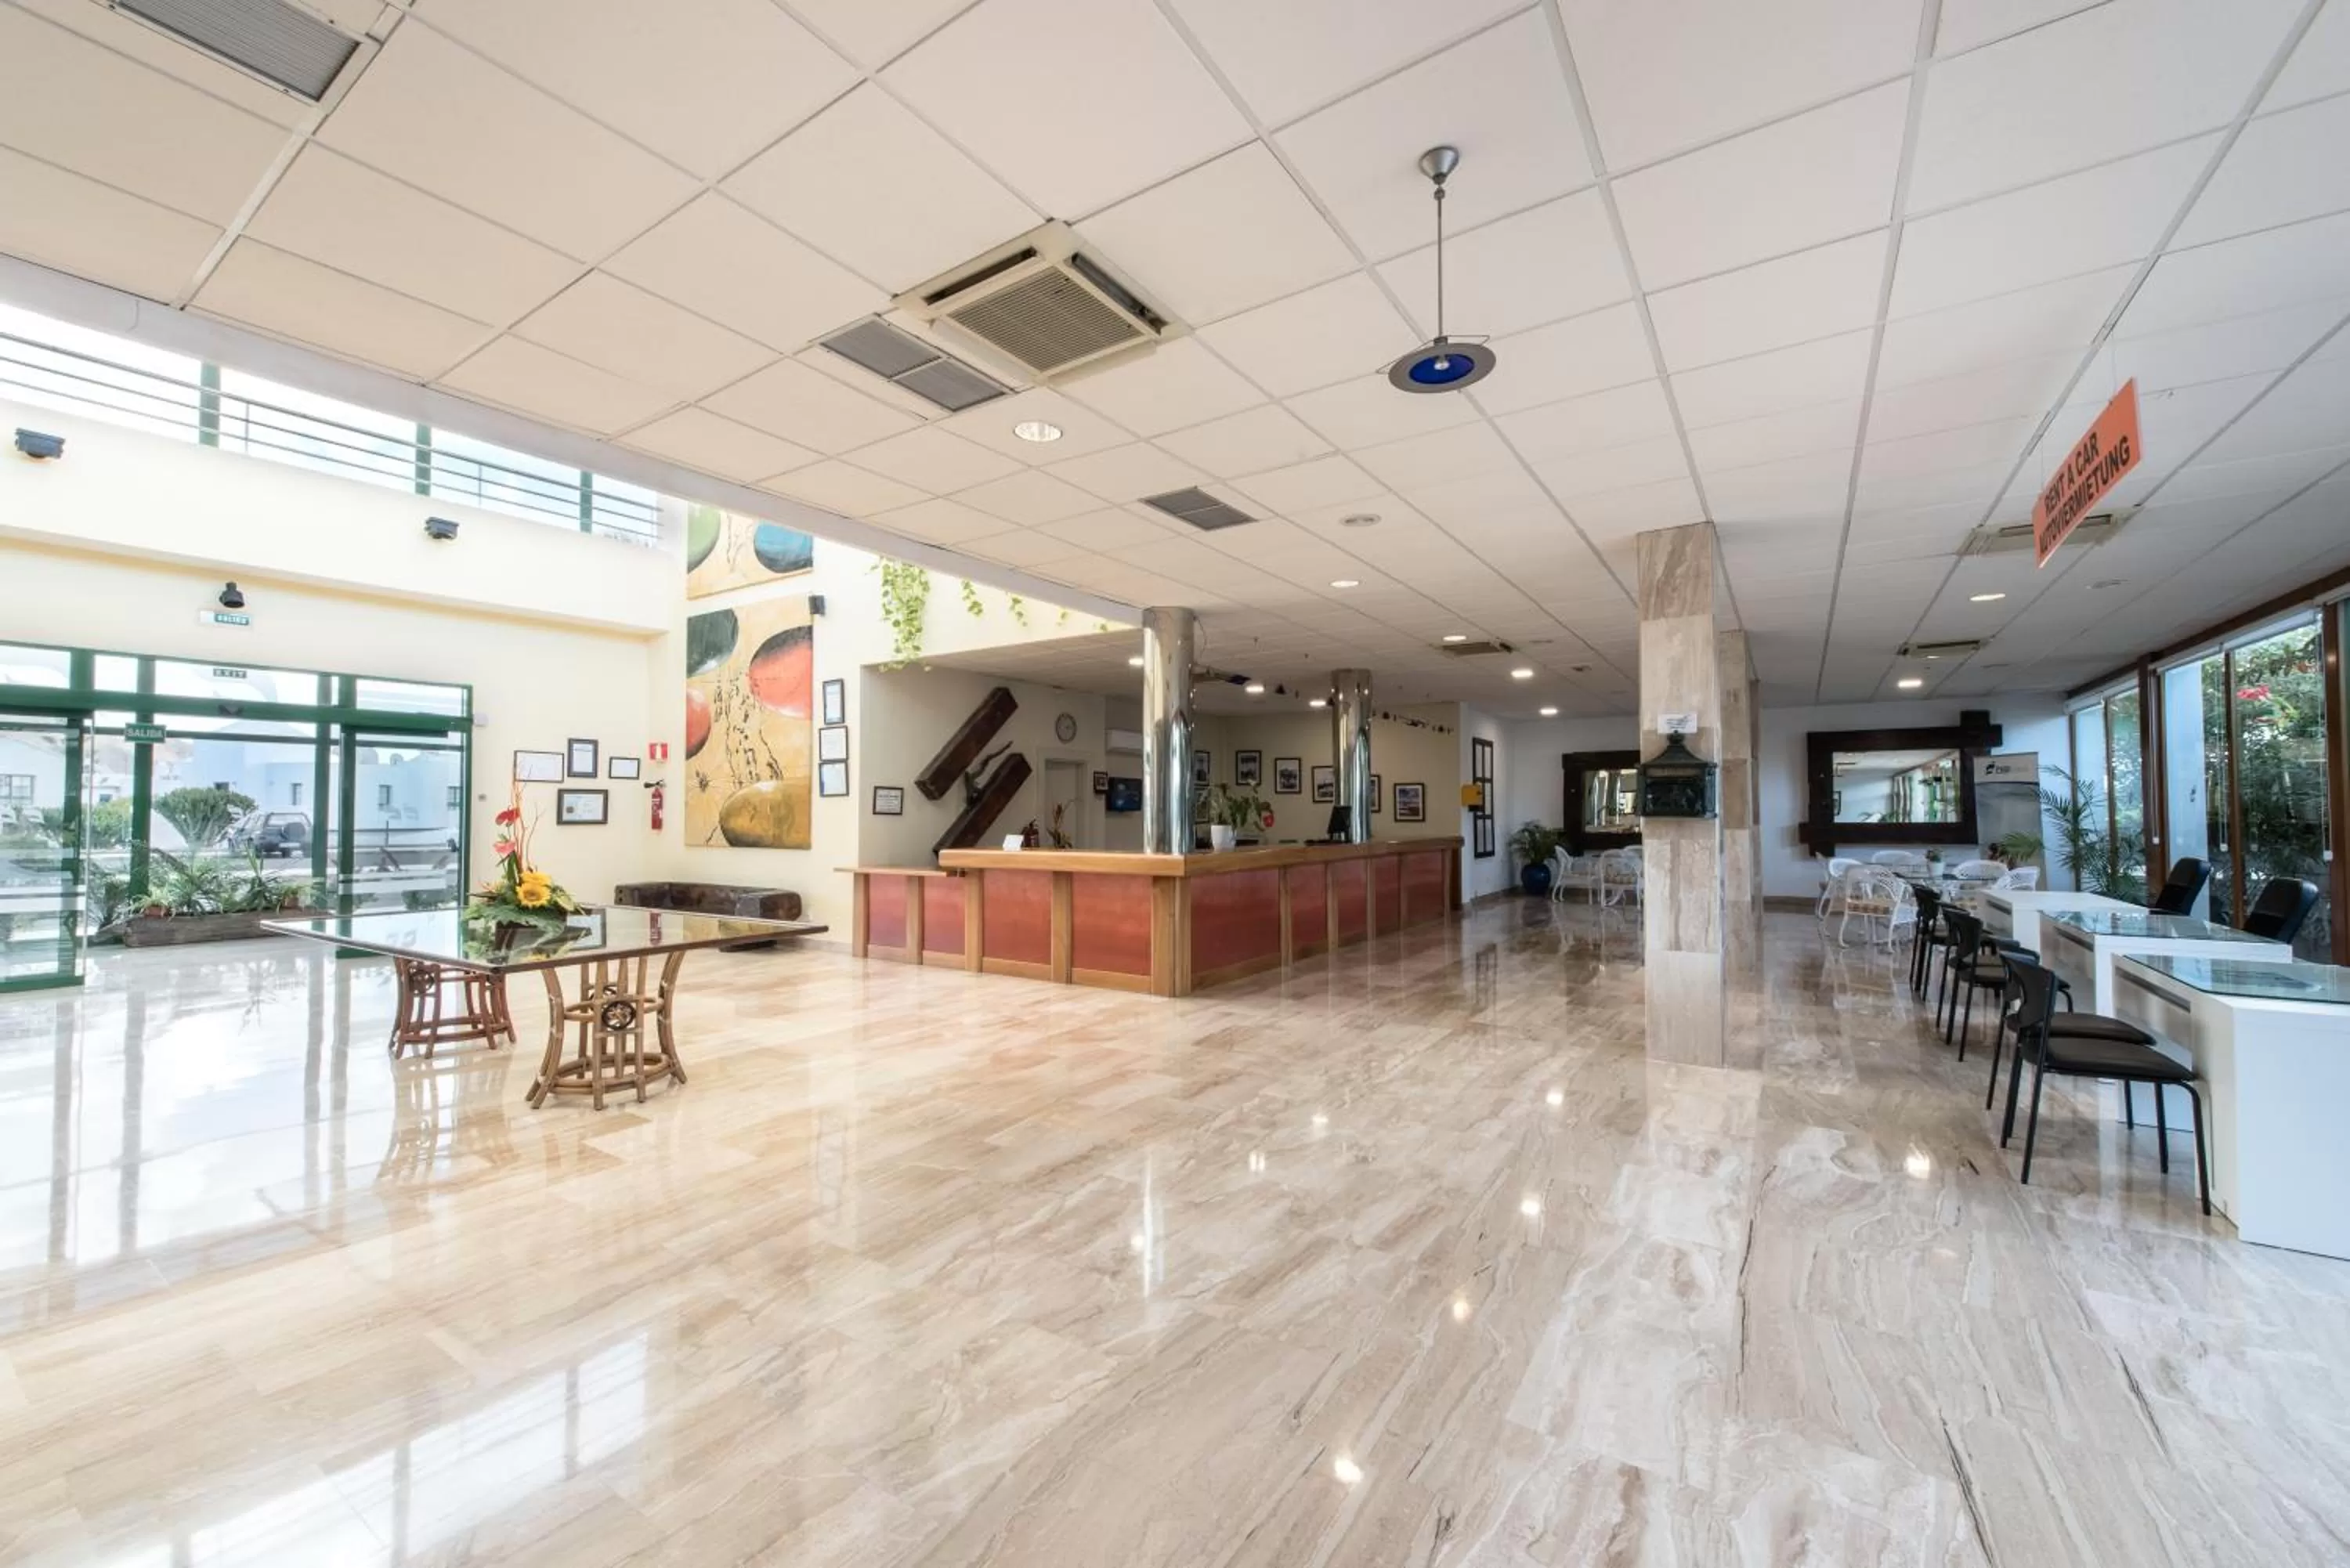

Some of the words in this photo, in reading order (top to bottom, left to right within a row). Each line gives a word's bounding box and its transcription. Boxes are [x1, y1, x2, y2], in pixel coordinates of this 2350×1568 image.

[2044, 472, 2065, 515] RENT
[2068, 463, 2075, 490] A
[2076, 432, 2099, 476] CAR
[127, 728, 164, 738] SALIDA
